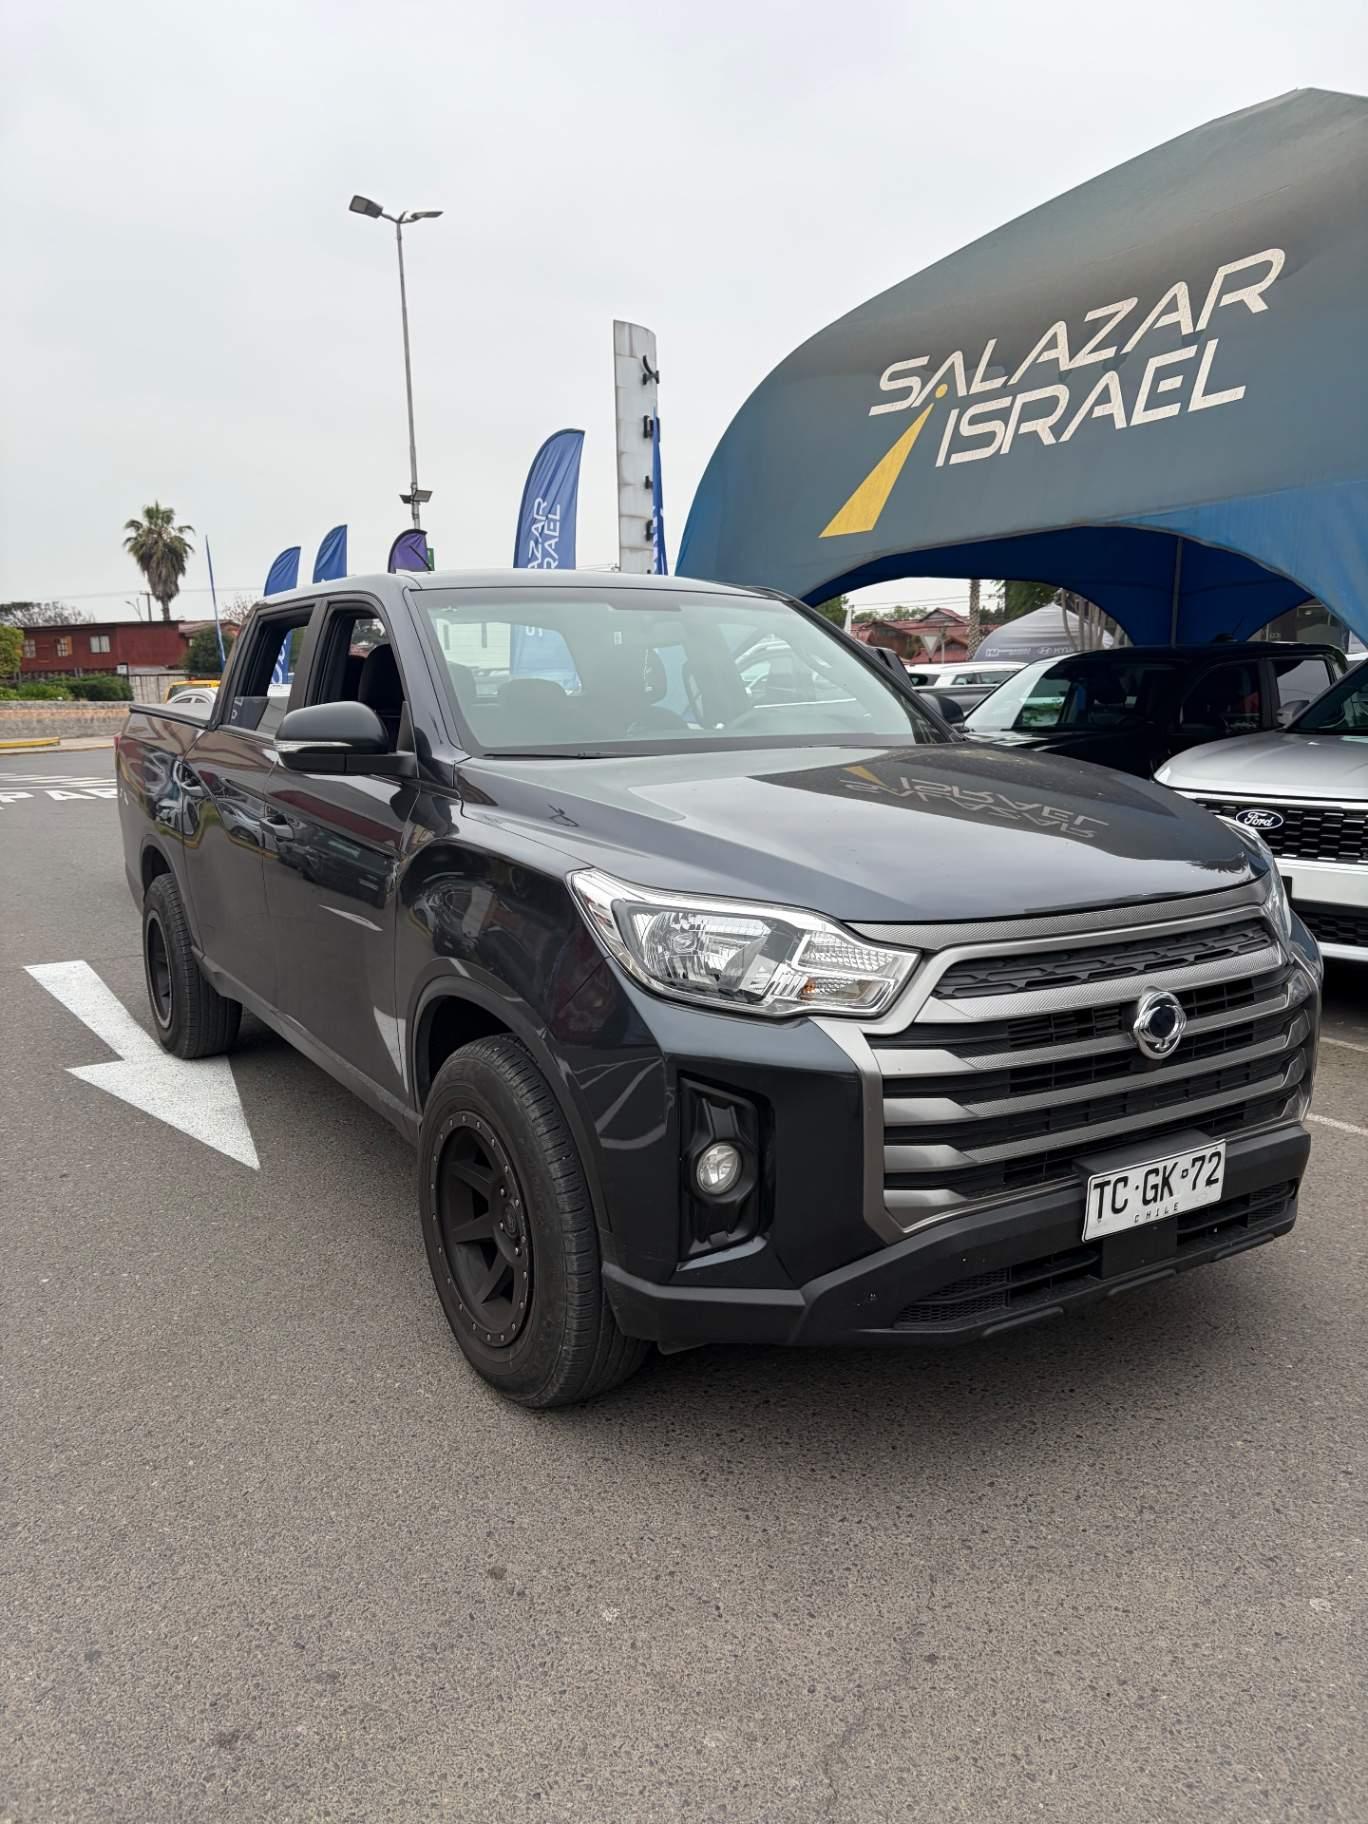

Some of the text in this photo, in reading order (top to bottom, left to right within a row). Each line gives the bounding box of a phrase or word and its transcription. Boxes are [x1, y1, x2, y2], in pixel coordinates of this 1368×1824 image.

[868, 248, 1286, 417] SALAZAR
[935, 338, 1247, 468] ISRAEL
[1244, 811, 1274, 827] Ford
[1134, 1202, 1178, 1223] CHILE
